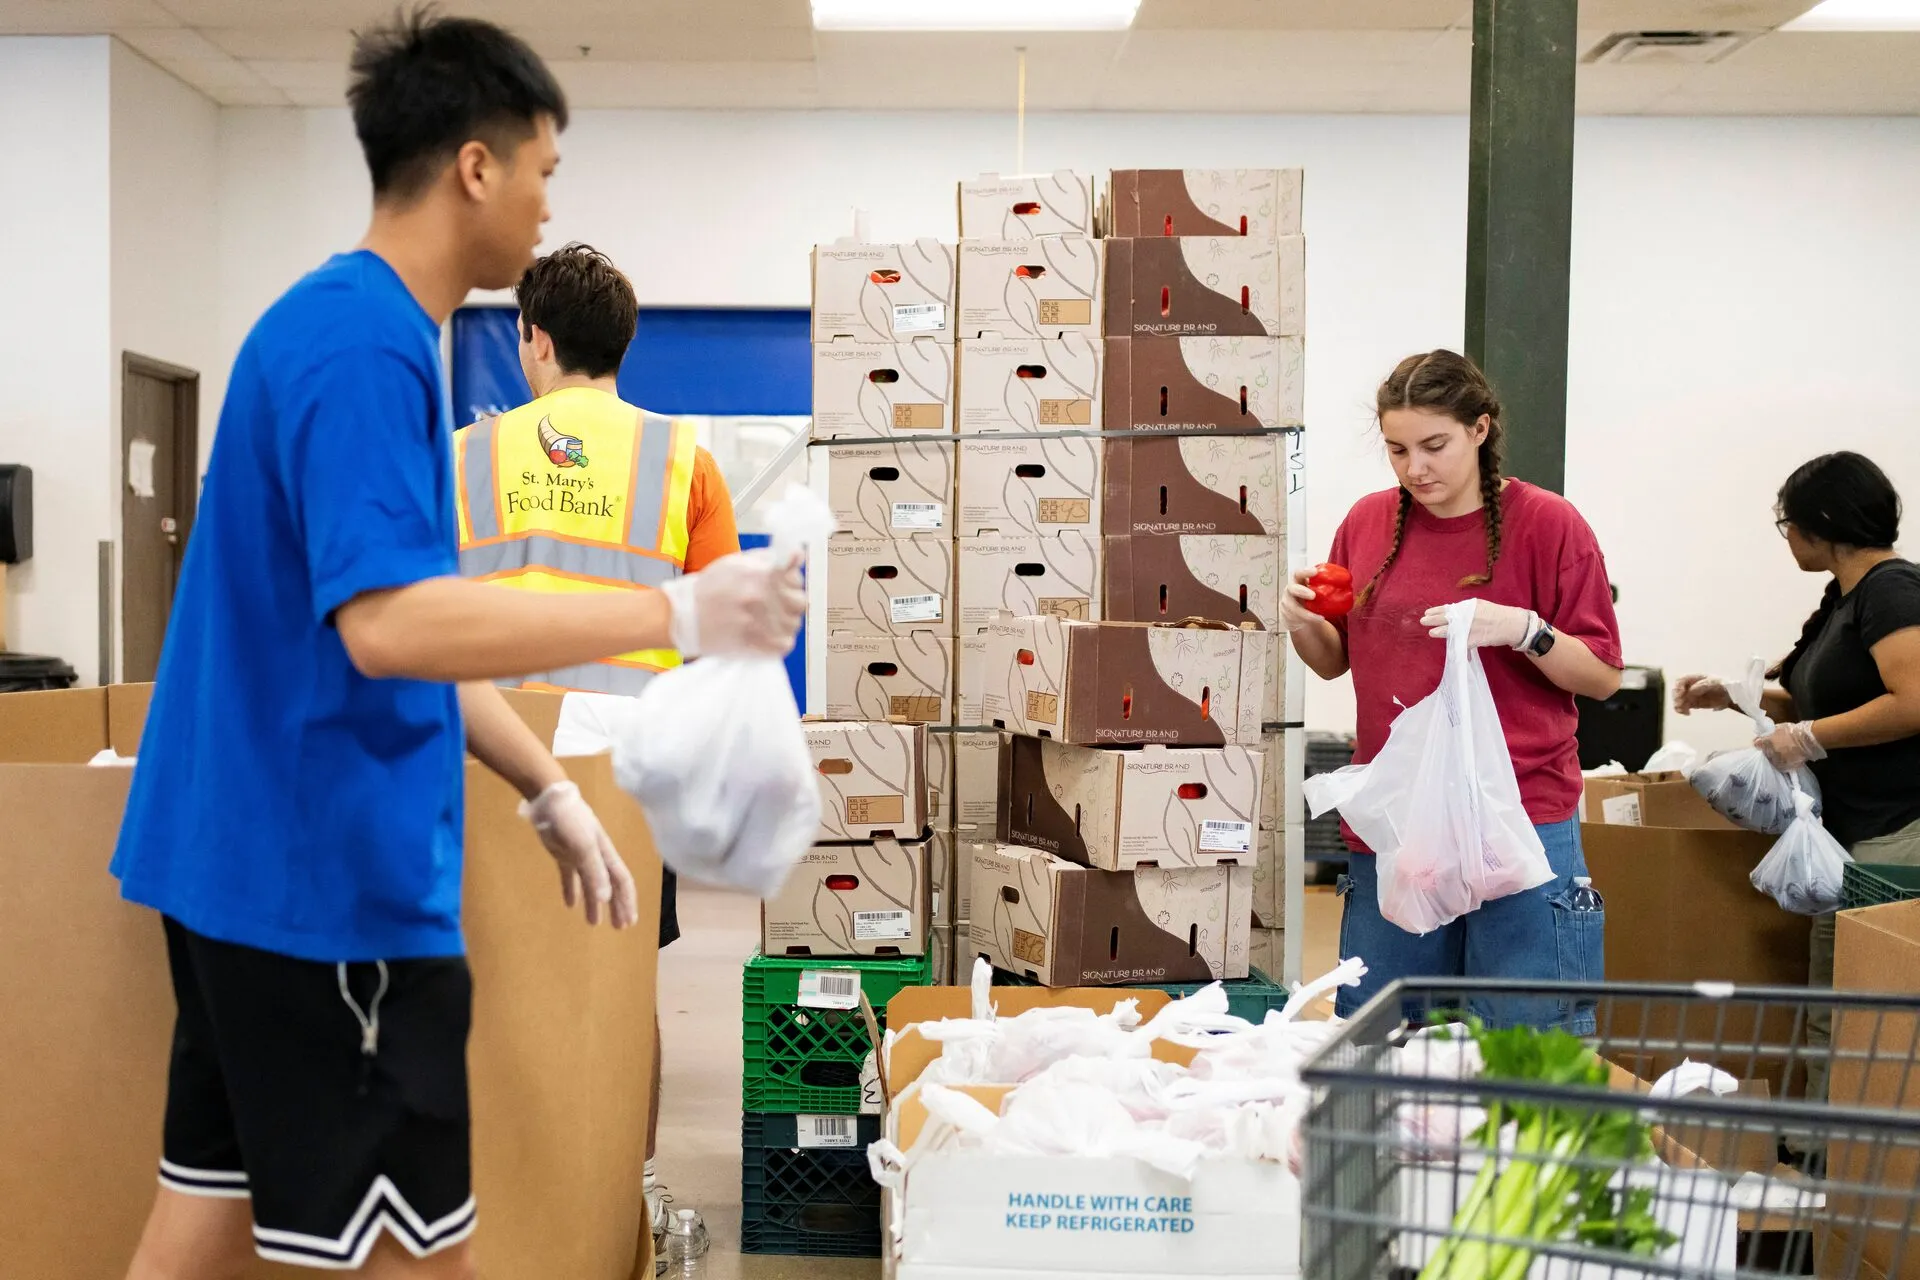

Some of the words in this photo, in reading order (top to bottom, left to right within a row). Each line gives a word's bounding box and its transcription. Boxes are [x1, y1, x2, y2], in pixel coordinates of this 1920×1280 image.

[1133, 323, 1181, 332] SIGNATURE
[1183, 323, 1217, 331] BRAND
[1133, 423, 1180, 432] SIGNATURE
[522, 471, 540, 485] St.
[546, 473, 594, 493] Mary's
[507, 490, 553, 514] Food
[560, 491, 614, 518] Bank
[1133, 522, 1180, 531] SIGNATURE
[1182, 522, 1216, 530] BRAND
[1095, 728, 1144, 738] SIGNATURE
[1145, 729, 1179, 738] BRAND
[1038, 836, 1060, 849] BRAND
[1082, 970, 1130, 980] SIGNATURE
[1131, 967, 1166, 977] BRAND
[1008, 1192, 1085, 1210] HANDLE
[1090, 1195, 1139, 1212] WITH
[1144, 1196, 1193, 1213] CARE
[1006, 1213, 1052, 1229] KEEP
[1056, 1216, 1194, 1234] REFRIGERATED
